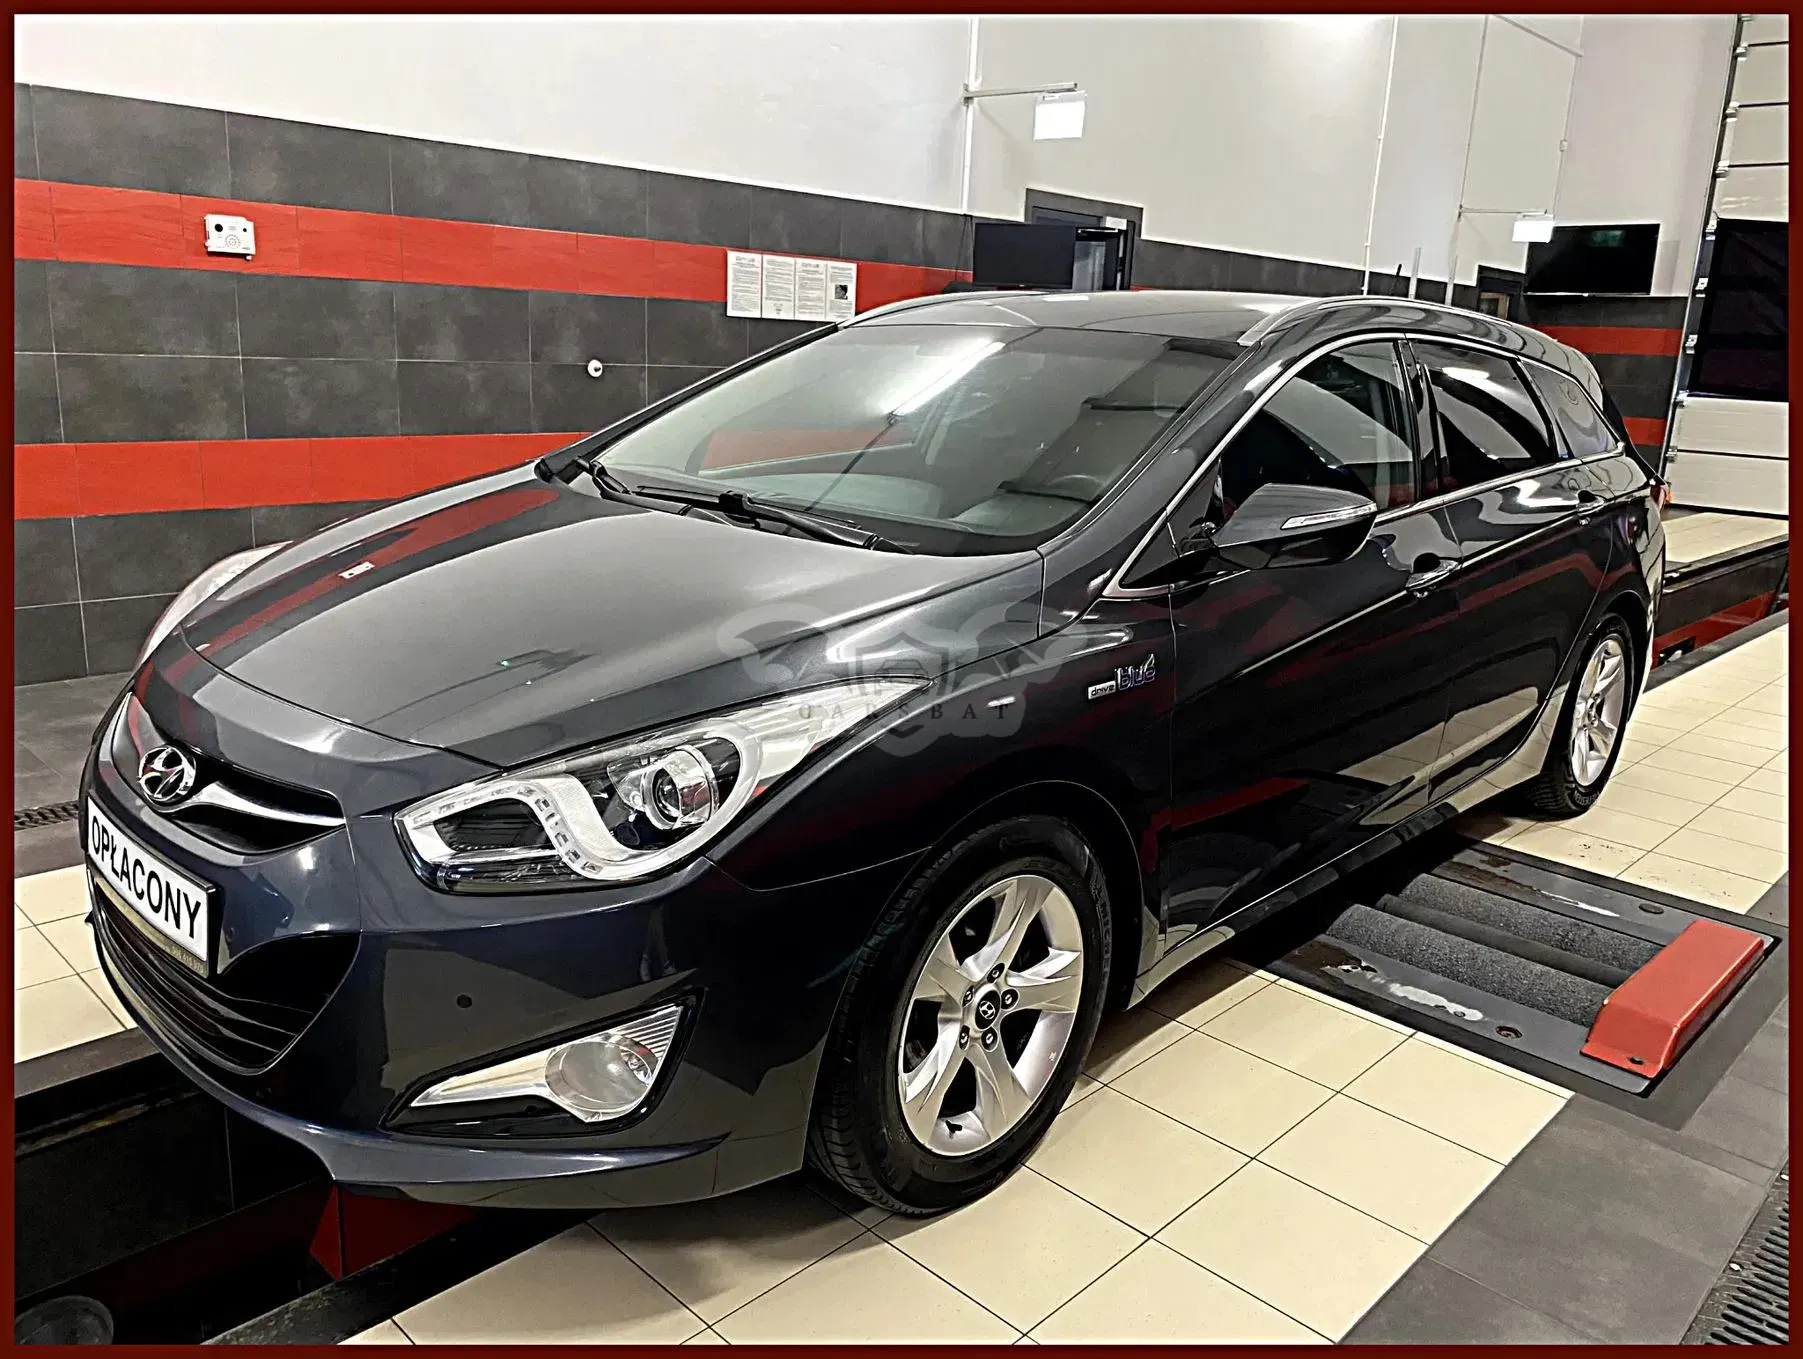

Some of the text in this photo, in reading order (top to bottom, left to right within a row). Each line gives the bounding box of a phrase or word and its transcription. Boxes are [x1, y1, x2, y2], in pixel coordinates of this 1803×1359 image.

[1090, 653, 1156, 697] drive blue
[91, 815, 202, 940] OPŁACONY
